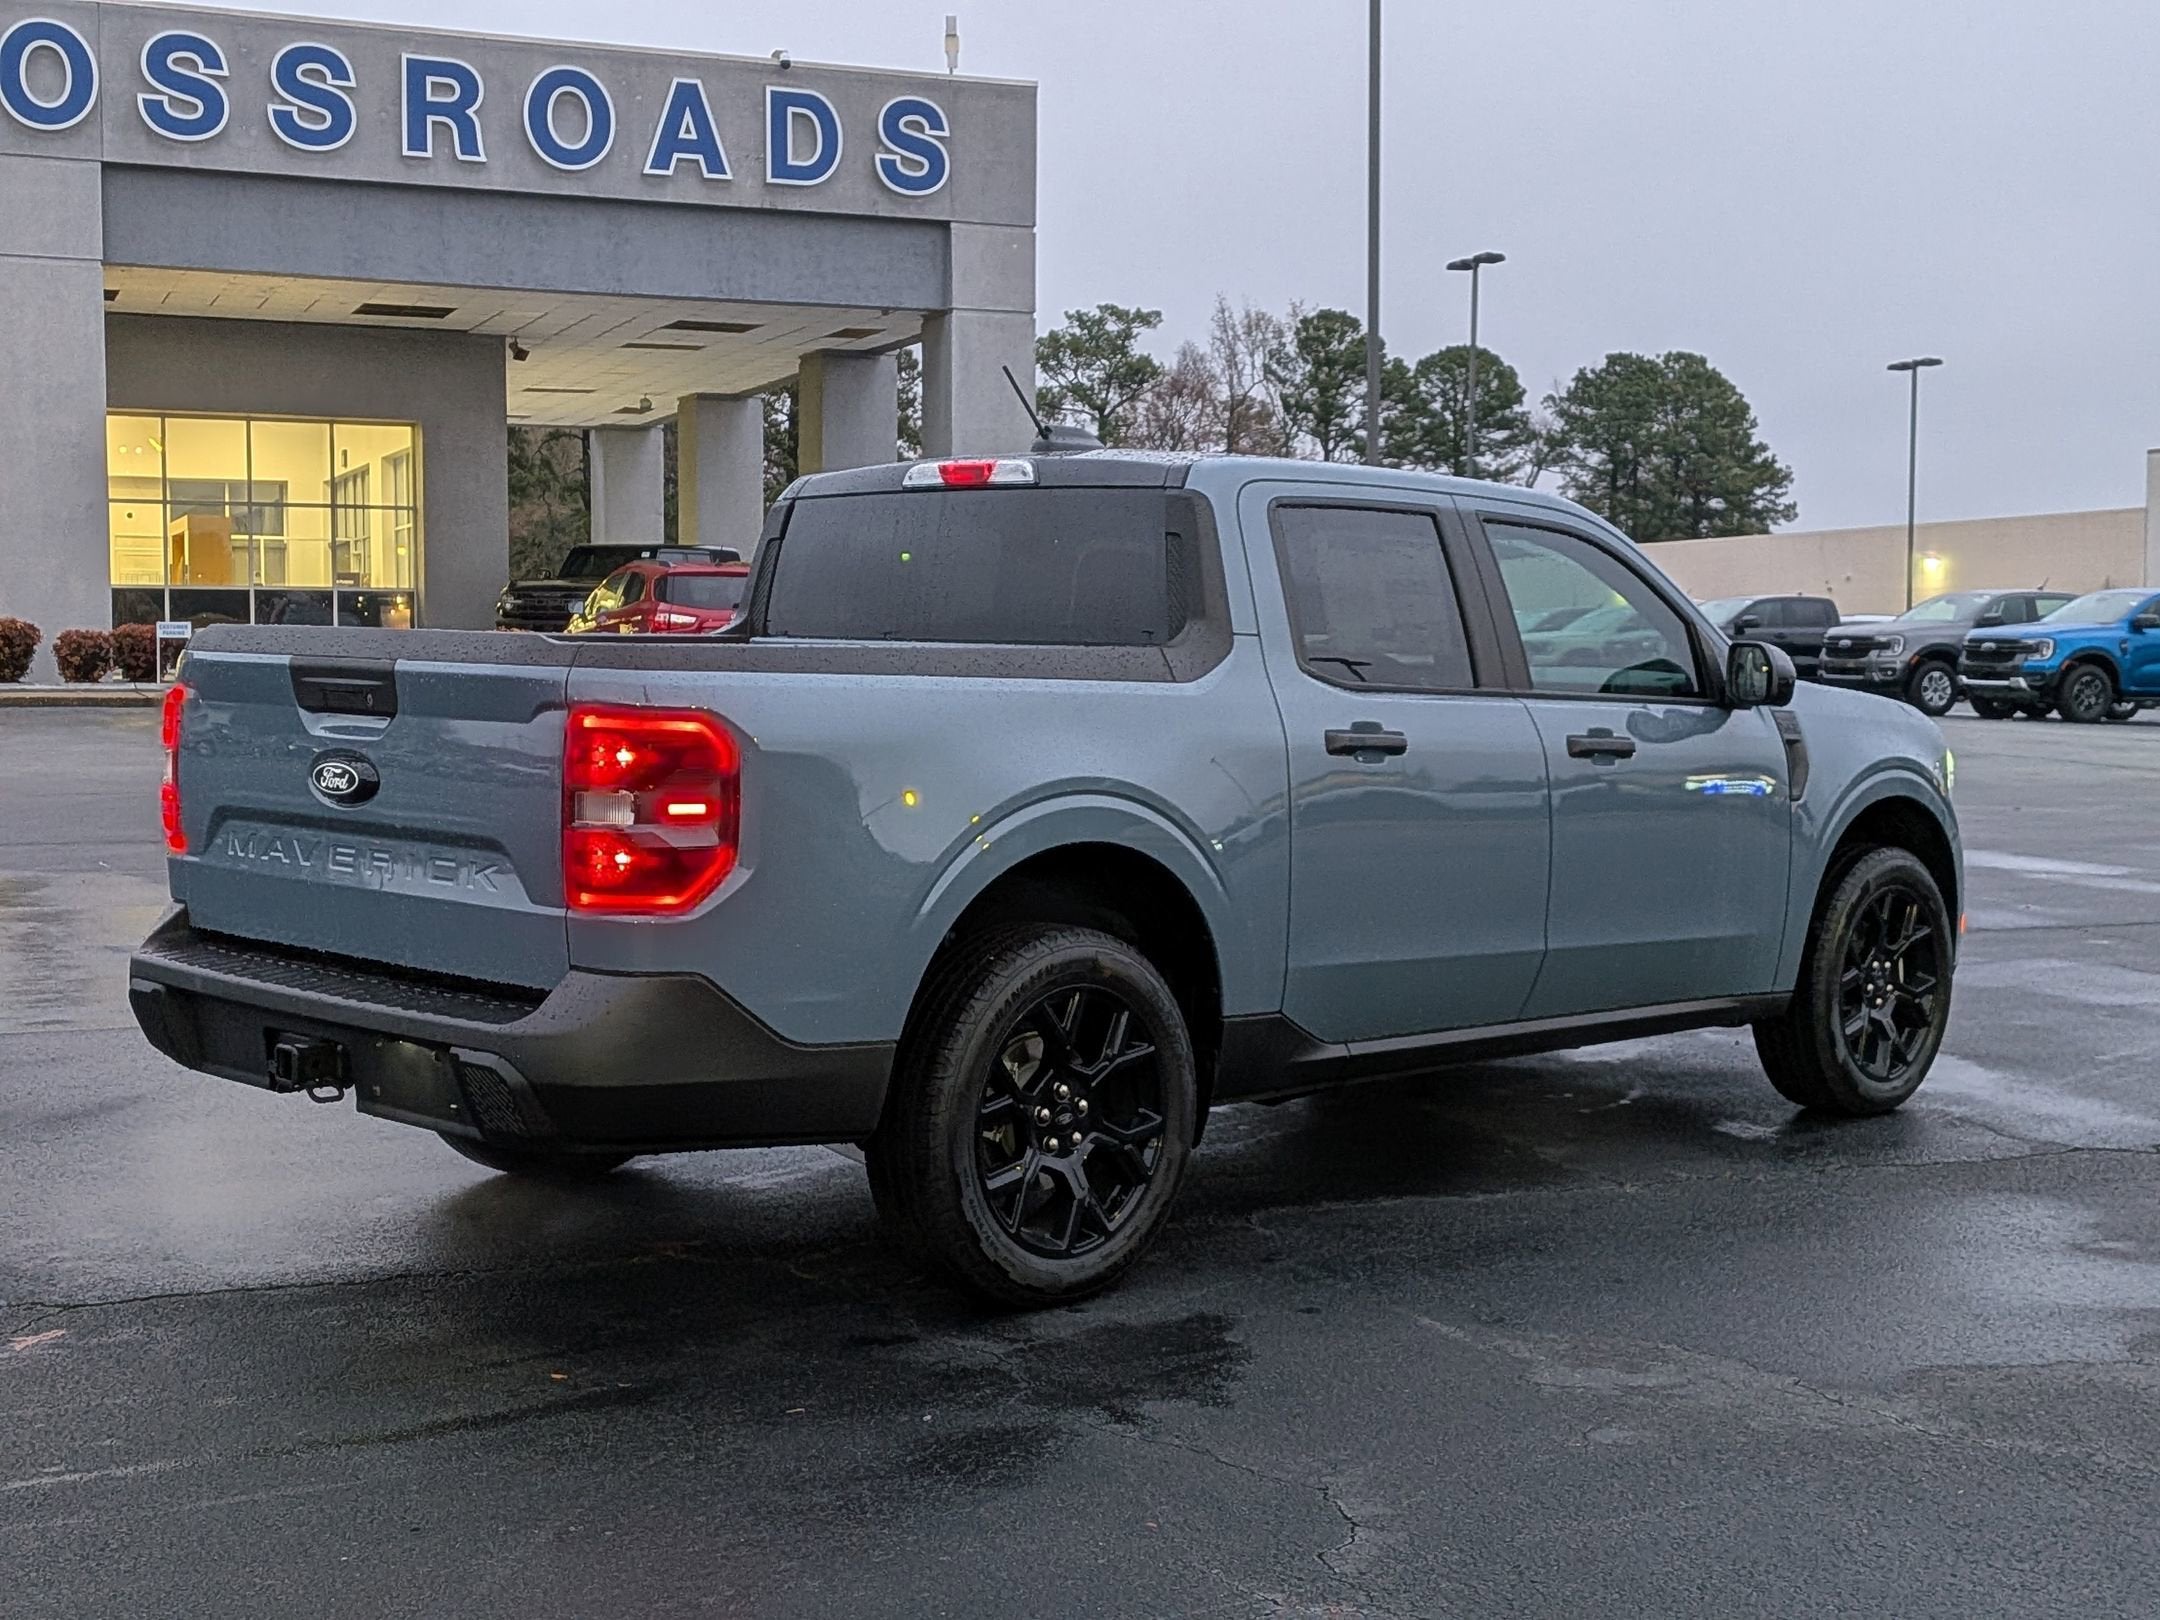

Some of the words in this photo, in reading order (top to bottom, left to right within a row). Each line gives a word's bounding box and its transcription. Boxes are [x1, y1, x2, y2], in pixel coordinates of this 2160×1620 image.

[0, 17, 951, 197] OSSROADS
[320, 767, 349, 789] Ford
[226, 830, 500, 892] MAVERICK
